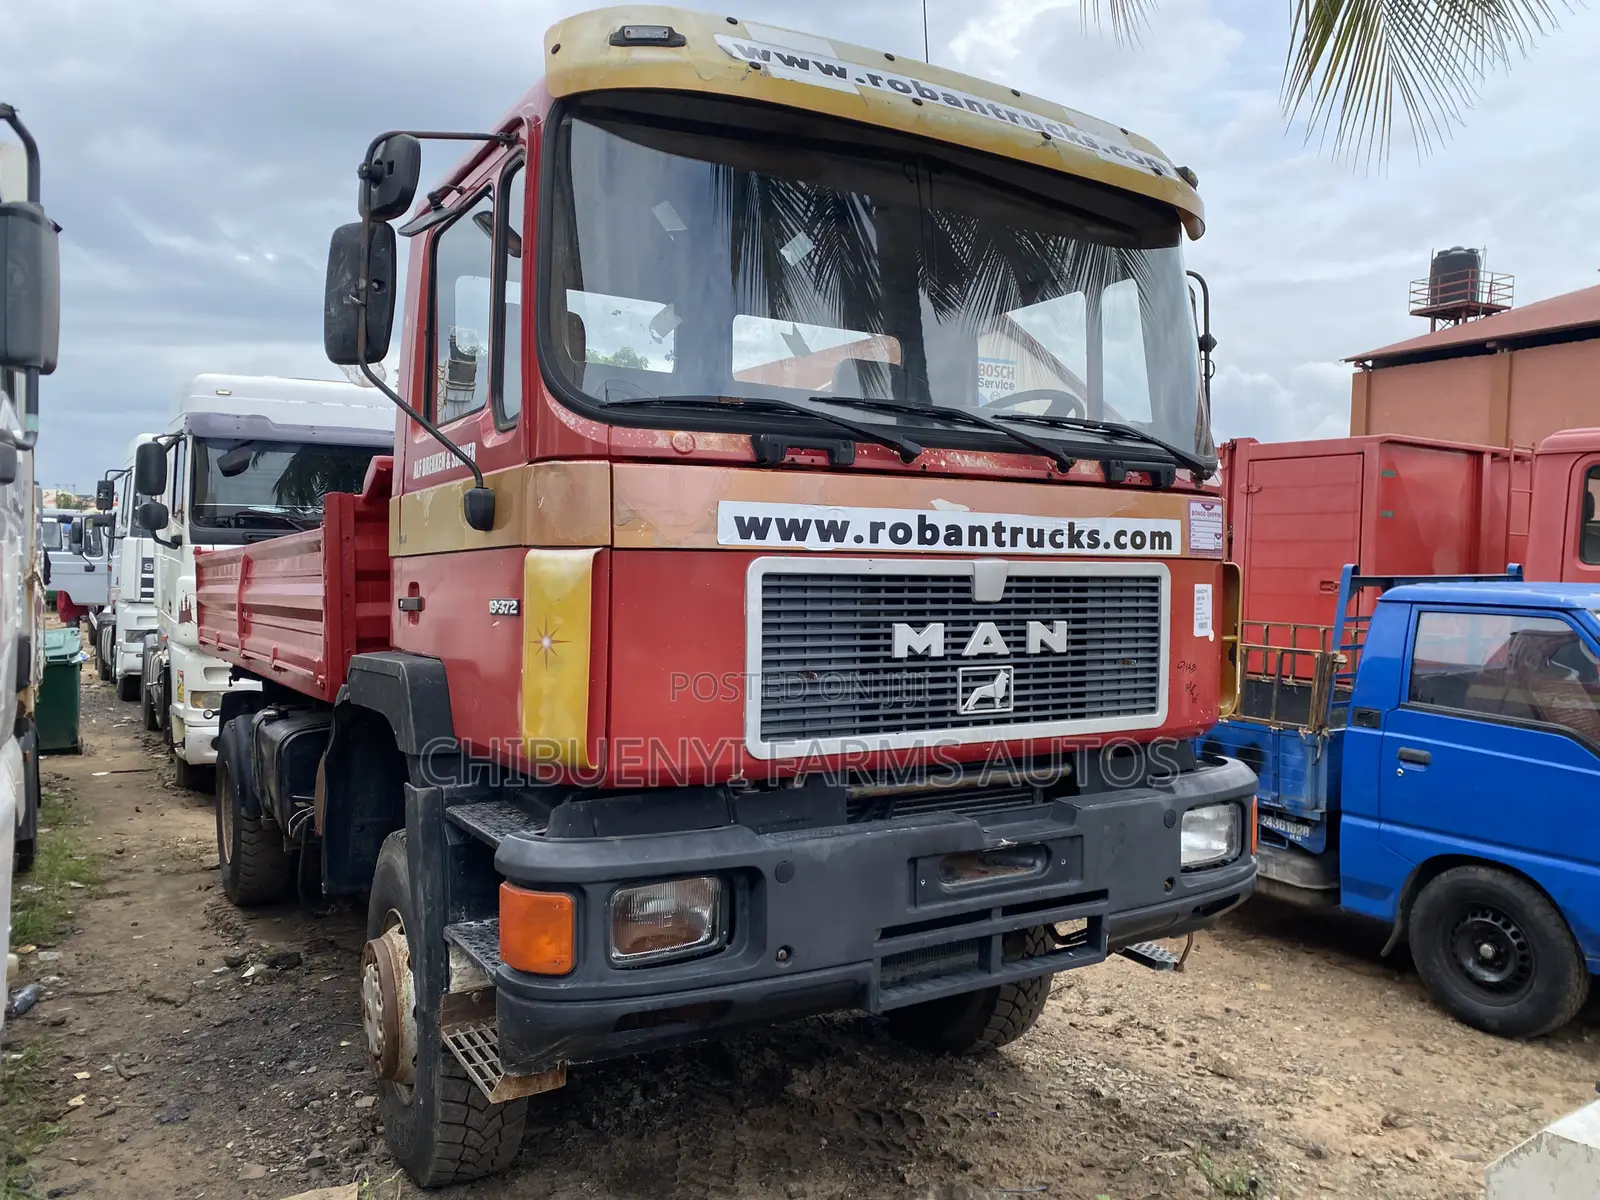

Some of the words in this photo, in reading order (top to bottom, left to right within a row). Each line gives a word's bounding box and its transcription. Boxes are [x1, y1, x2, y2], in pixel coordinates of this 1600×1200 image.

[733, 43, 1172, 175] www.robantrucks.com
[978, 377, 1016, 391] Service
[979, 363, 1015, 381] BOSCH
[733, 514, 1173, 551] www.robantrucks.com
[891, 620, 1068, 659] MAN
